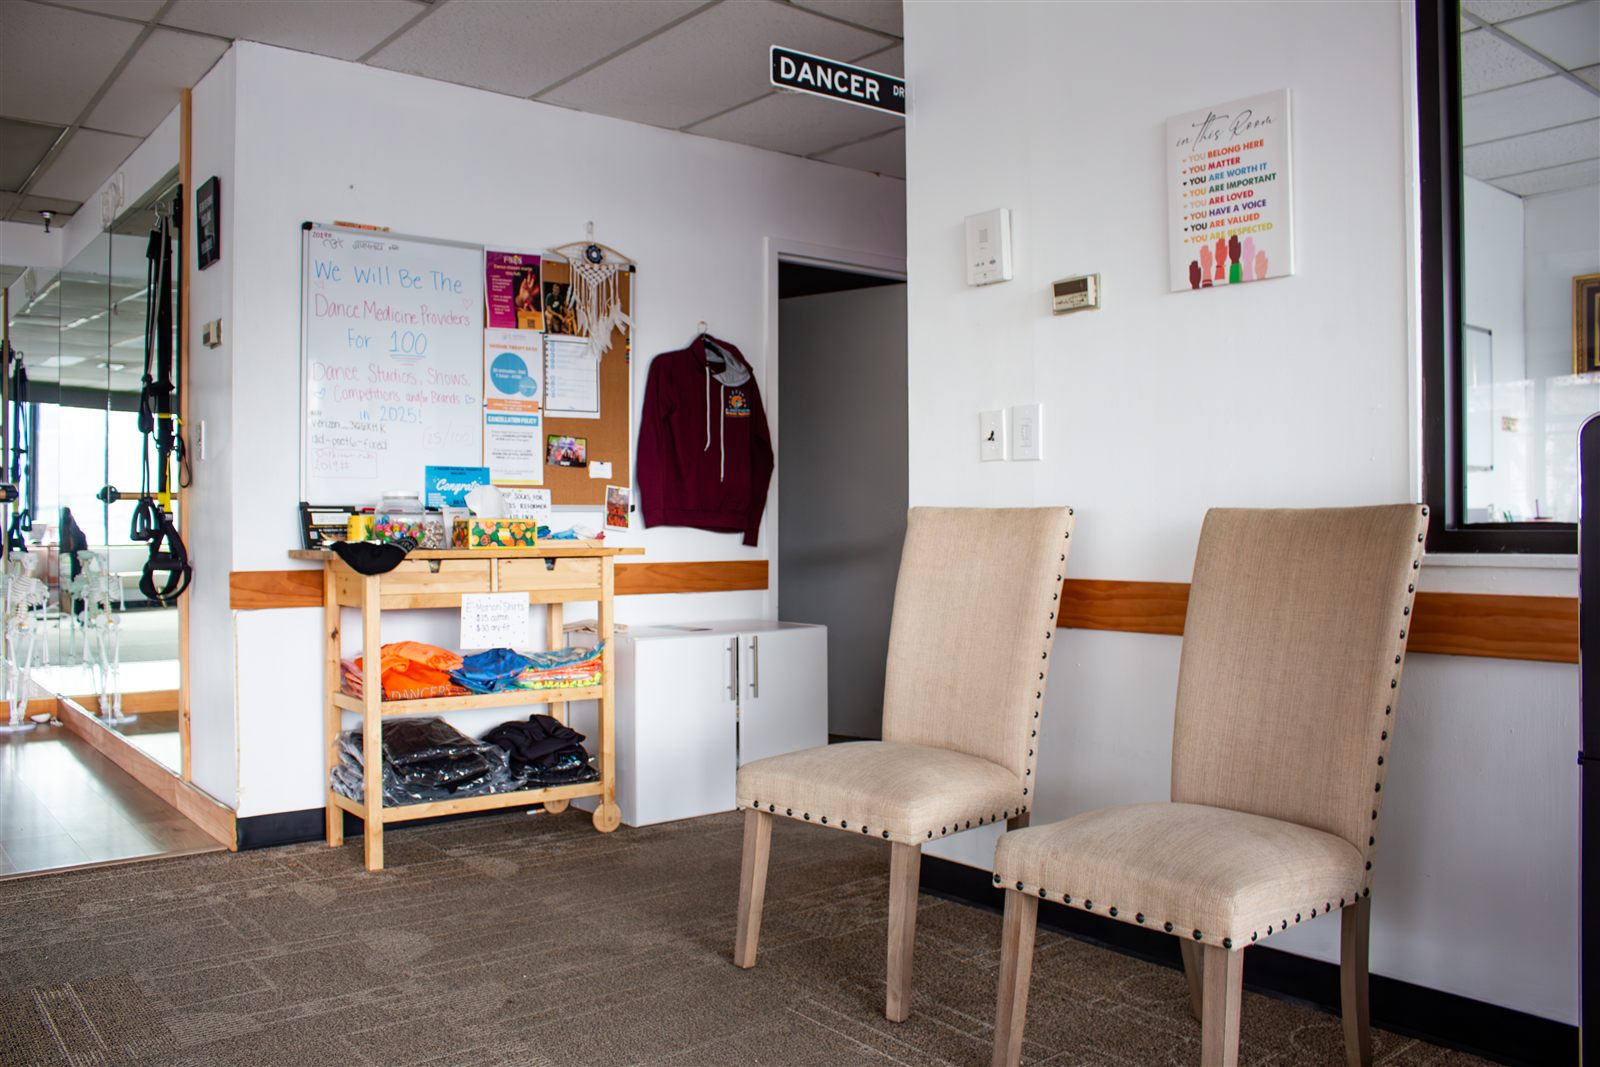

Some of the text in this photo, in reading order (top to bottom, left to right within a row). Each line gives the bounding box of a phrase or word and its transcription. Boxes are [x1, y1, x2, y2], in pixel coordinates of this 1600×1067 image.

[780, 56, 880, 102] DANCER
[1191, 111, 1229, 152] This
[1229, 109, 1276, 139] Room
[1189, 139, 1264, 162] YOU BELONG HERE
[1189, 157, 1241, 174] YOU MATTER
[1189, 162, 1268, 186] YOU ARE WORTH IT
[1189, 172, 1277, 198] YOU ARE IMPORTANT
[1190, 190, 1254, 209] YOU ARE LOVED
[1190, 199, 1267, 220] YOU HAVE A VOICE
[1190, 212, 1260, 232] YOU ARE VALUED
[1190, 222, 1273, 243] YOU ARE RESPECTED
[314, 258, 342, 282] We
[353, 264, 390, 286] Will
[397, 268, 423, 289] Be
[429, 270, 463, 294] The
[314, 293, 360, 318] Dance
[363, 300, 418, 325] Medicine
[420, 303, 471, 326] Providers
[346, 327, 428, 355] For 100
[312, 361, 360, 381] Dance
[333, 384, 401, 403] Competitions
[431, 390, 460, 405] Brands
[359, 405, 423, 425] in 2025!
[487, 415, 537, 425] CANCELLATION POLICY
